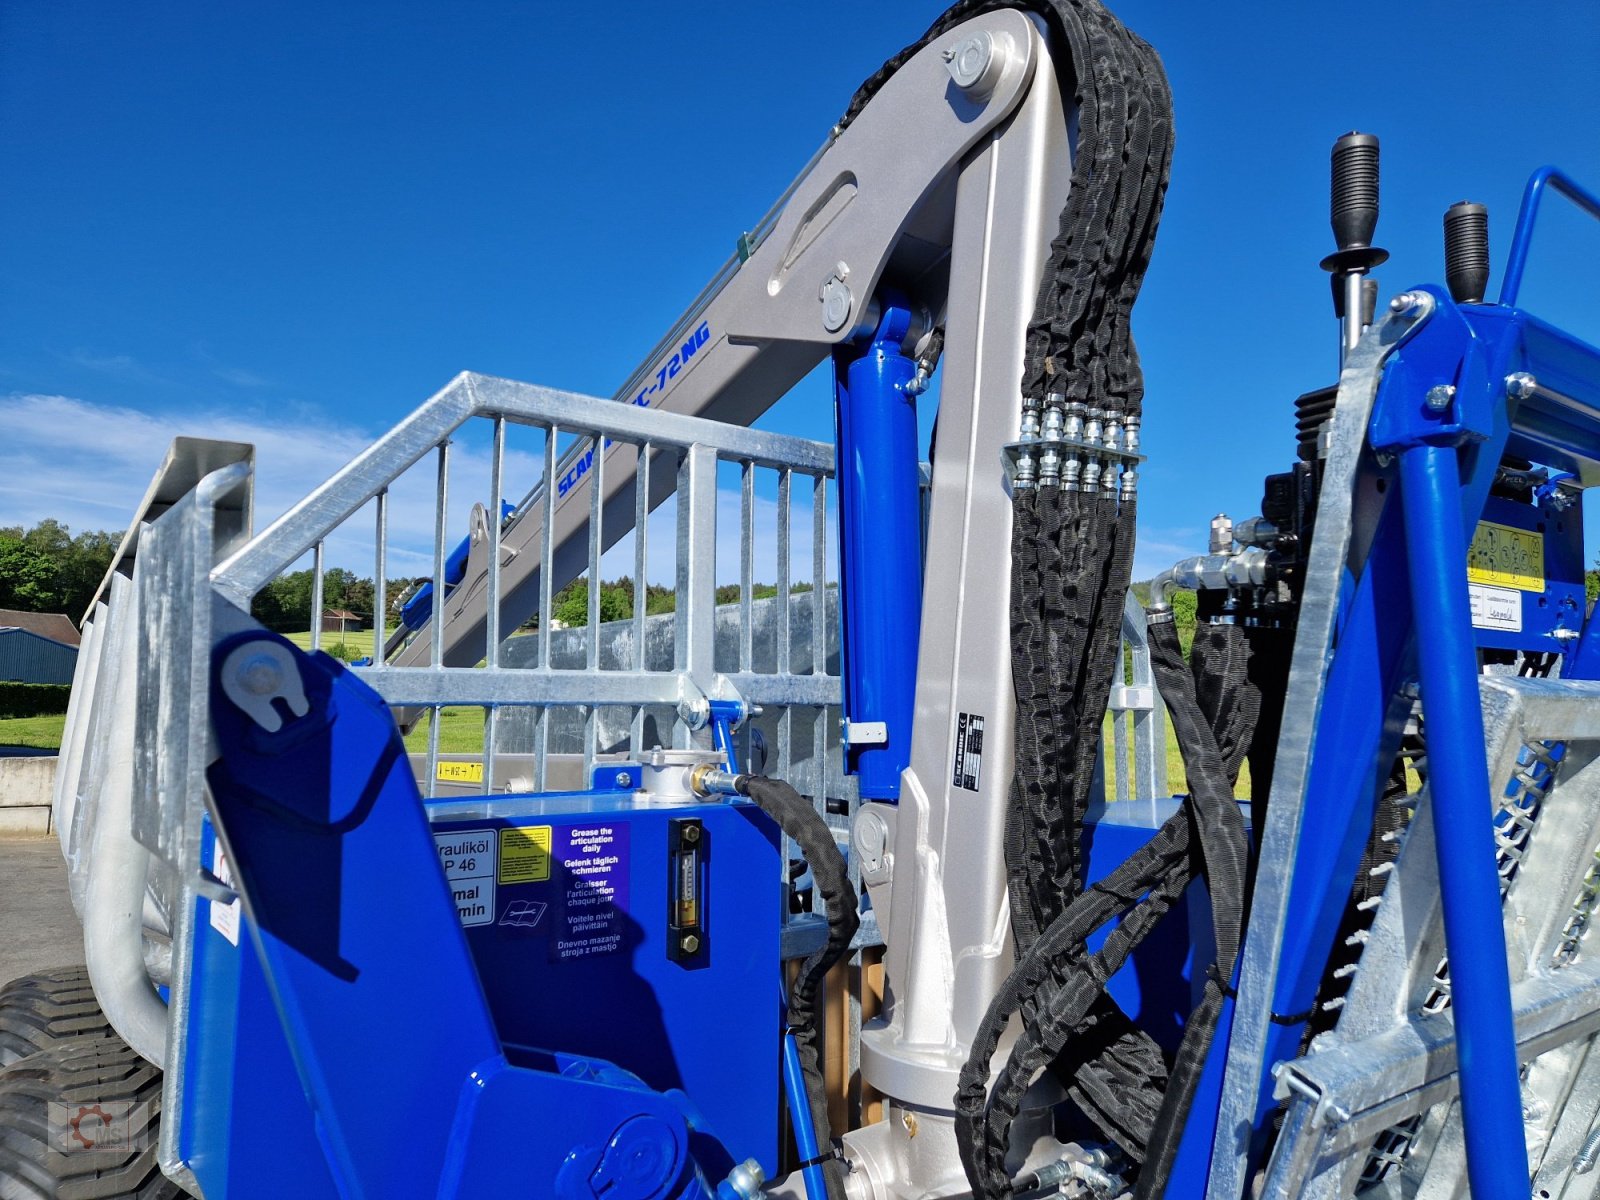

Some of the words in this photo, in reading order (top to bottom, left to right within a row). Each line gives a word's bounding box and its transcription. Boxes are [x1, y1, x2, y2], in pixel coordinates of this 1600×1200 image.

[632, 320, 710, 408] C-72NG
[956, 731, 965, 775] SCANDIC
[571, 829, 599, 837] Grease
[570, 835, 613, 845] articulation
[436, 840, 489, 856] rauliköl
[582, 844, 601, 853] daily
[459, 858, 476, 871] 46
[564, 858, 591, 867] Gelenk
[593, 856, 618, 866] täglich
[571, 866, 611, 875] schmieren
[575, 880, 607, 889] Graisser
[567, 887, 614, 898] l'articulation
[568, 898, 596, 907] chaque
[597, 895, 613, 904] jour
[456, 904, 485, 917] min
[567, 914, 594, 924] Voitele
[596, 911, 614, 920] nivel
[558, 940, 588, 949] Dnevno
[590, 934, 620, 944] mazanje
[561, 947, 584, 957] stroja
[591, 943, 617, 952] mastjo
